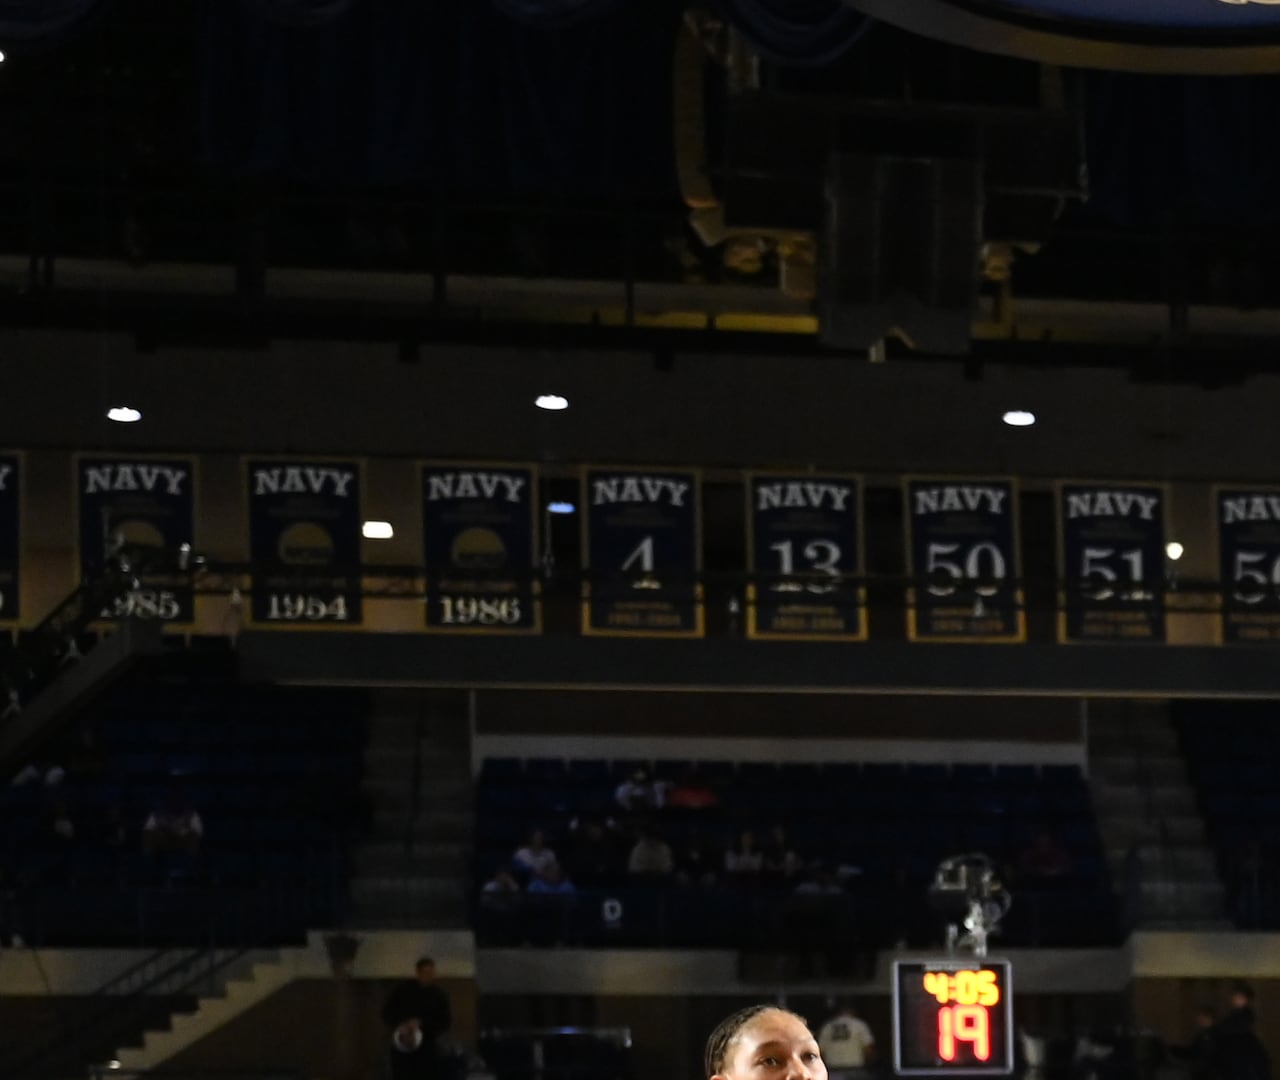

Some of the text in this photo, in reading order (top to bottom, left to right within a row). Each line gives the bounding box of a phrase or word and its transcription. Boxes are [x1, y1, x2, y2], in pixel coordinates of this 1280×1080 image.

[84, 464, 188, 496] NAVY
[254, 464, 354, 498] NAVY
[427, 472, 526, 503] NAVY
[592, 476, 689, 508] NAVY
[756, 481, 851, 511] NAVY
[914, 485, 1009, 516] NAVY
[1066, 491, 1160, 521] NAVY
[767, 538, 844, 595] 13
[923, 540, 1007, 597] 50
[1080, 546, 1155, 601] 51
[267, 594, 348, 621] 1954
[439, 595, 521, 625] 1986
[923, 969, 1000, 1006] 4:05
[937, 1003, 990, 1062] 19
